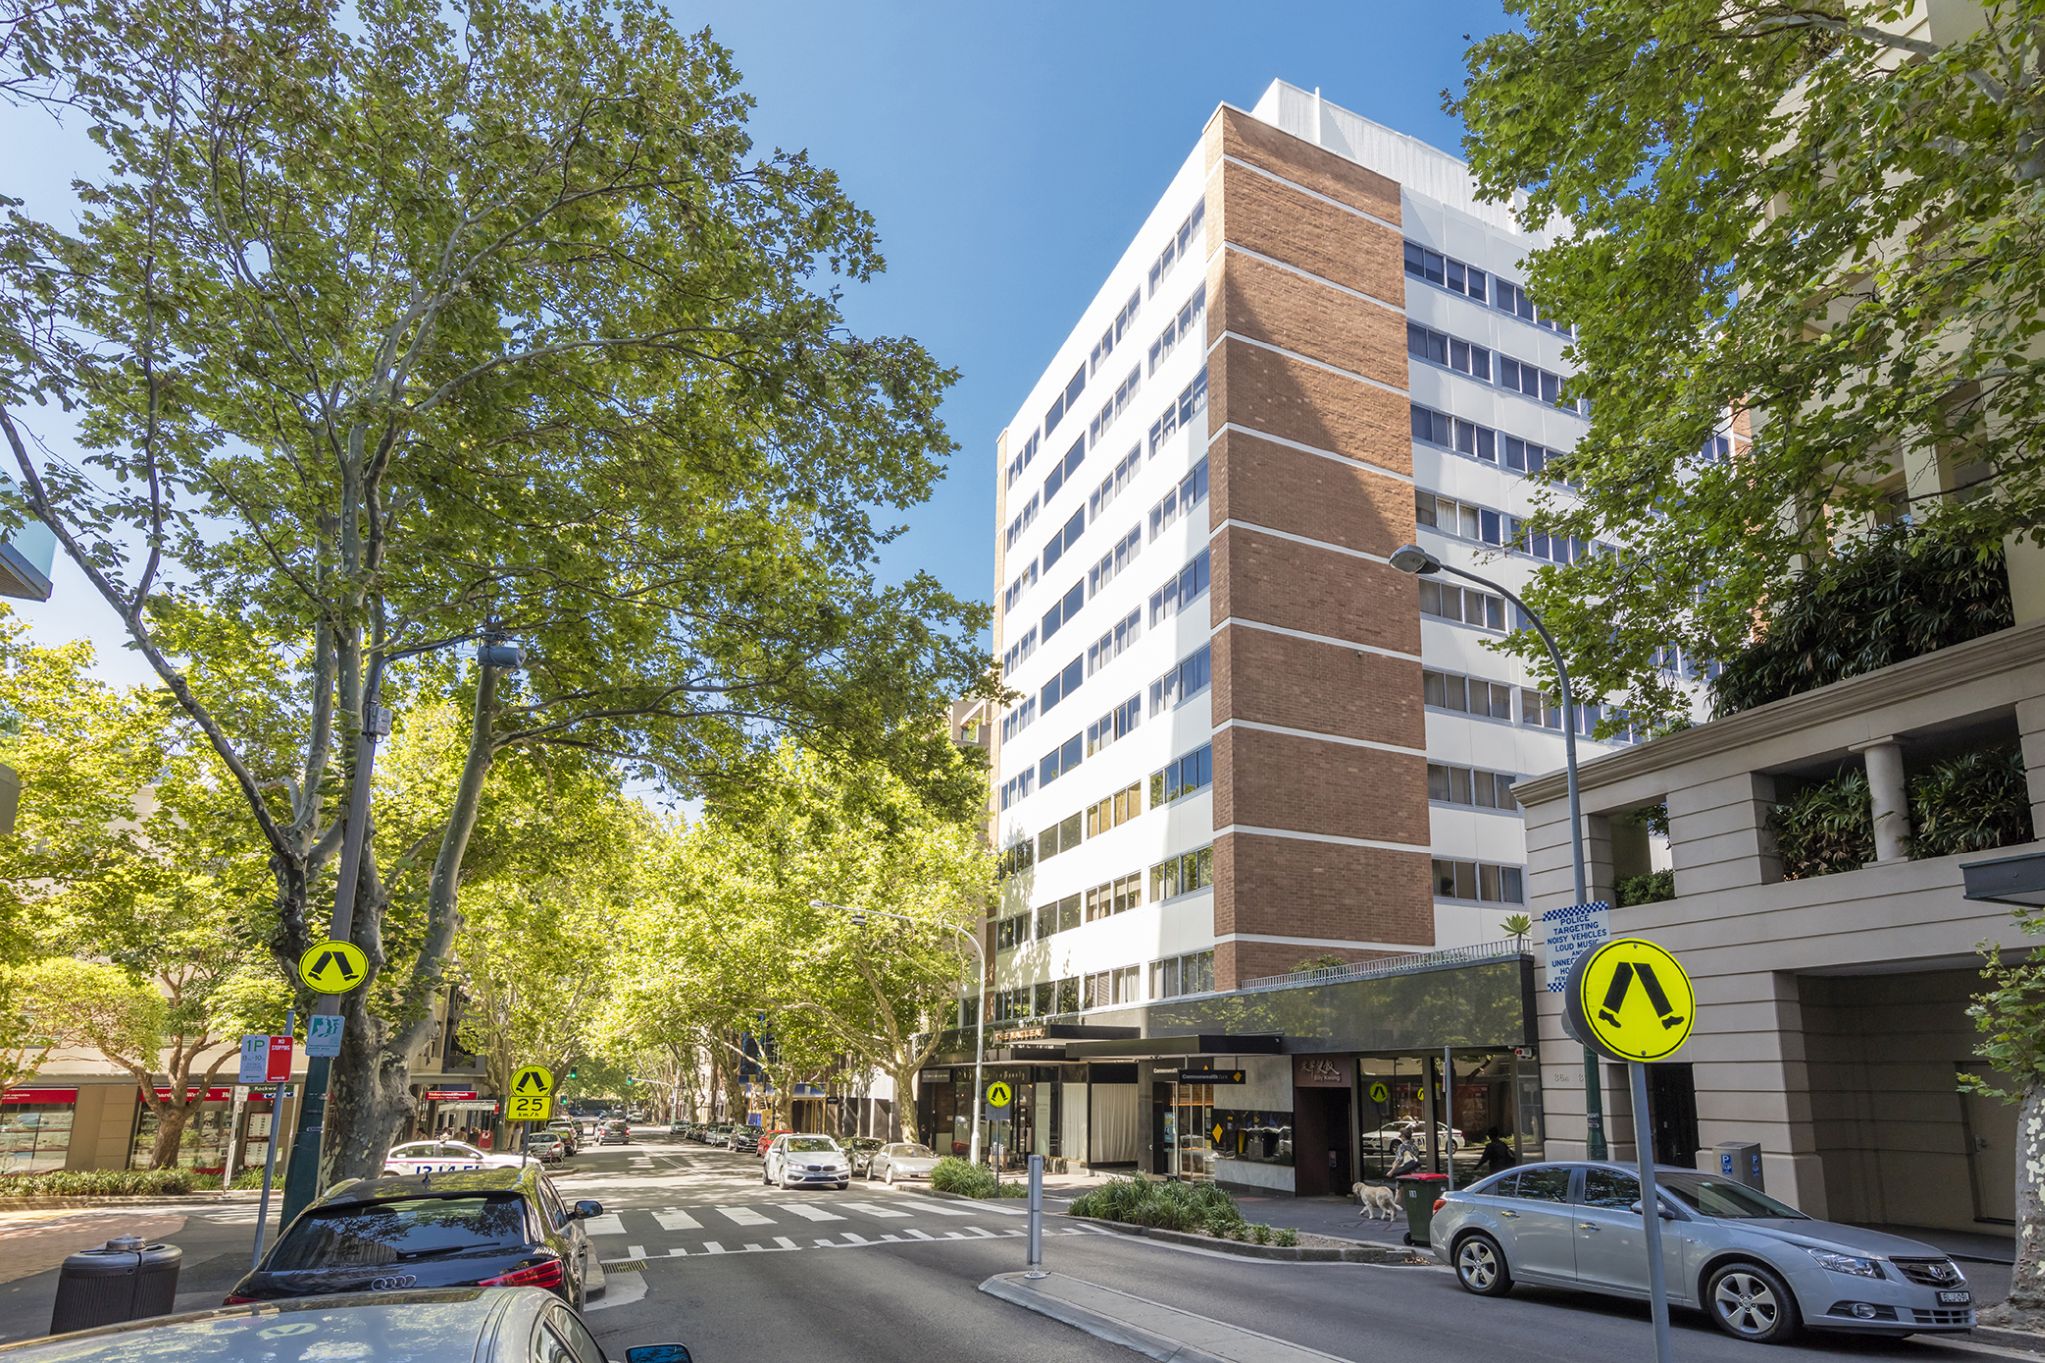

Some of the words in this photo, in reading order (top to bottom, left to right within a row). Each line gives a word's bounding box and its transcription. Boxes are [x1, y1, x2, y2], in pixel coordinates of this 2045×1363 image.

[1560, 914, 1590, 926] POLICE
[1553, 921, 1599, 935] TARGETING
[1547, 935, 1568, 945] NOISY
[1571, 929, 1607, 941] VEHICLES
[1555, 943, 1574, 952] LOUD
[247, 1039, 265, 1052] 1P
[516, 1098, 543, 1111] 25
